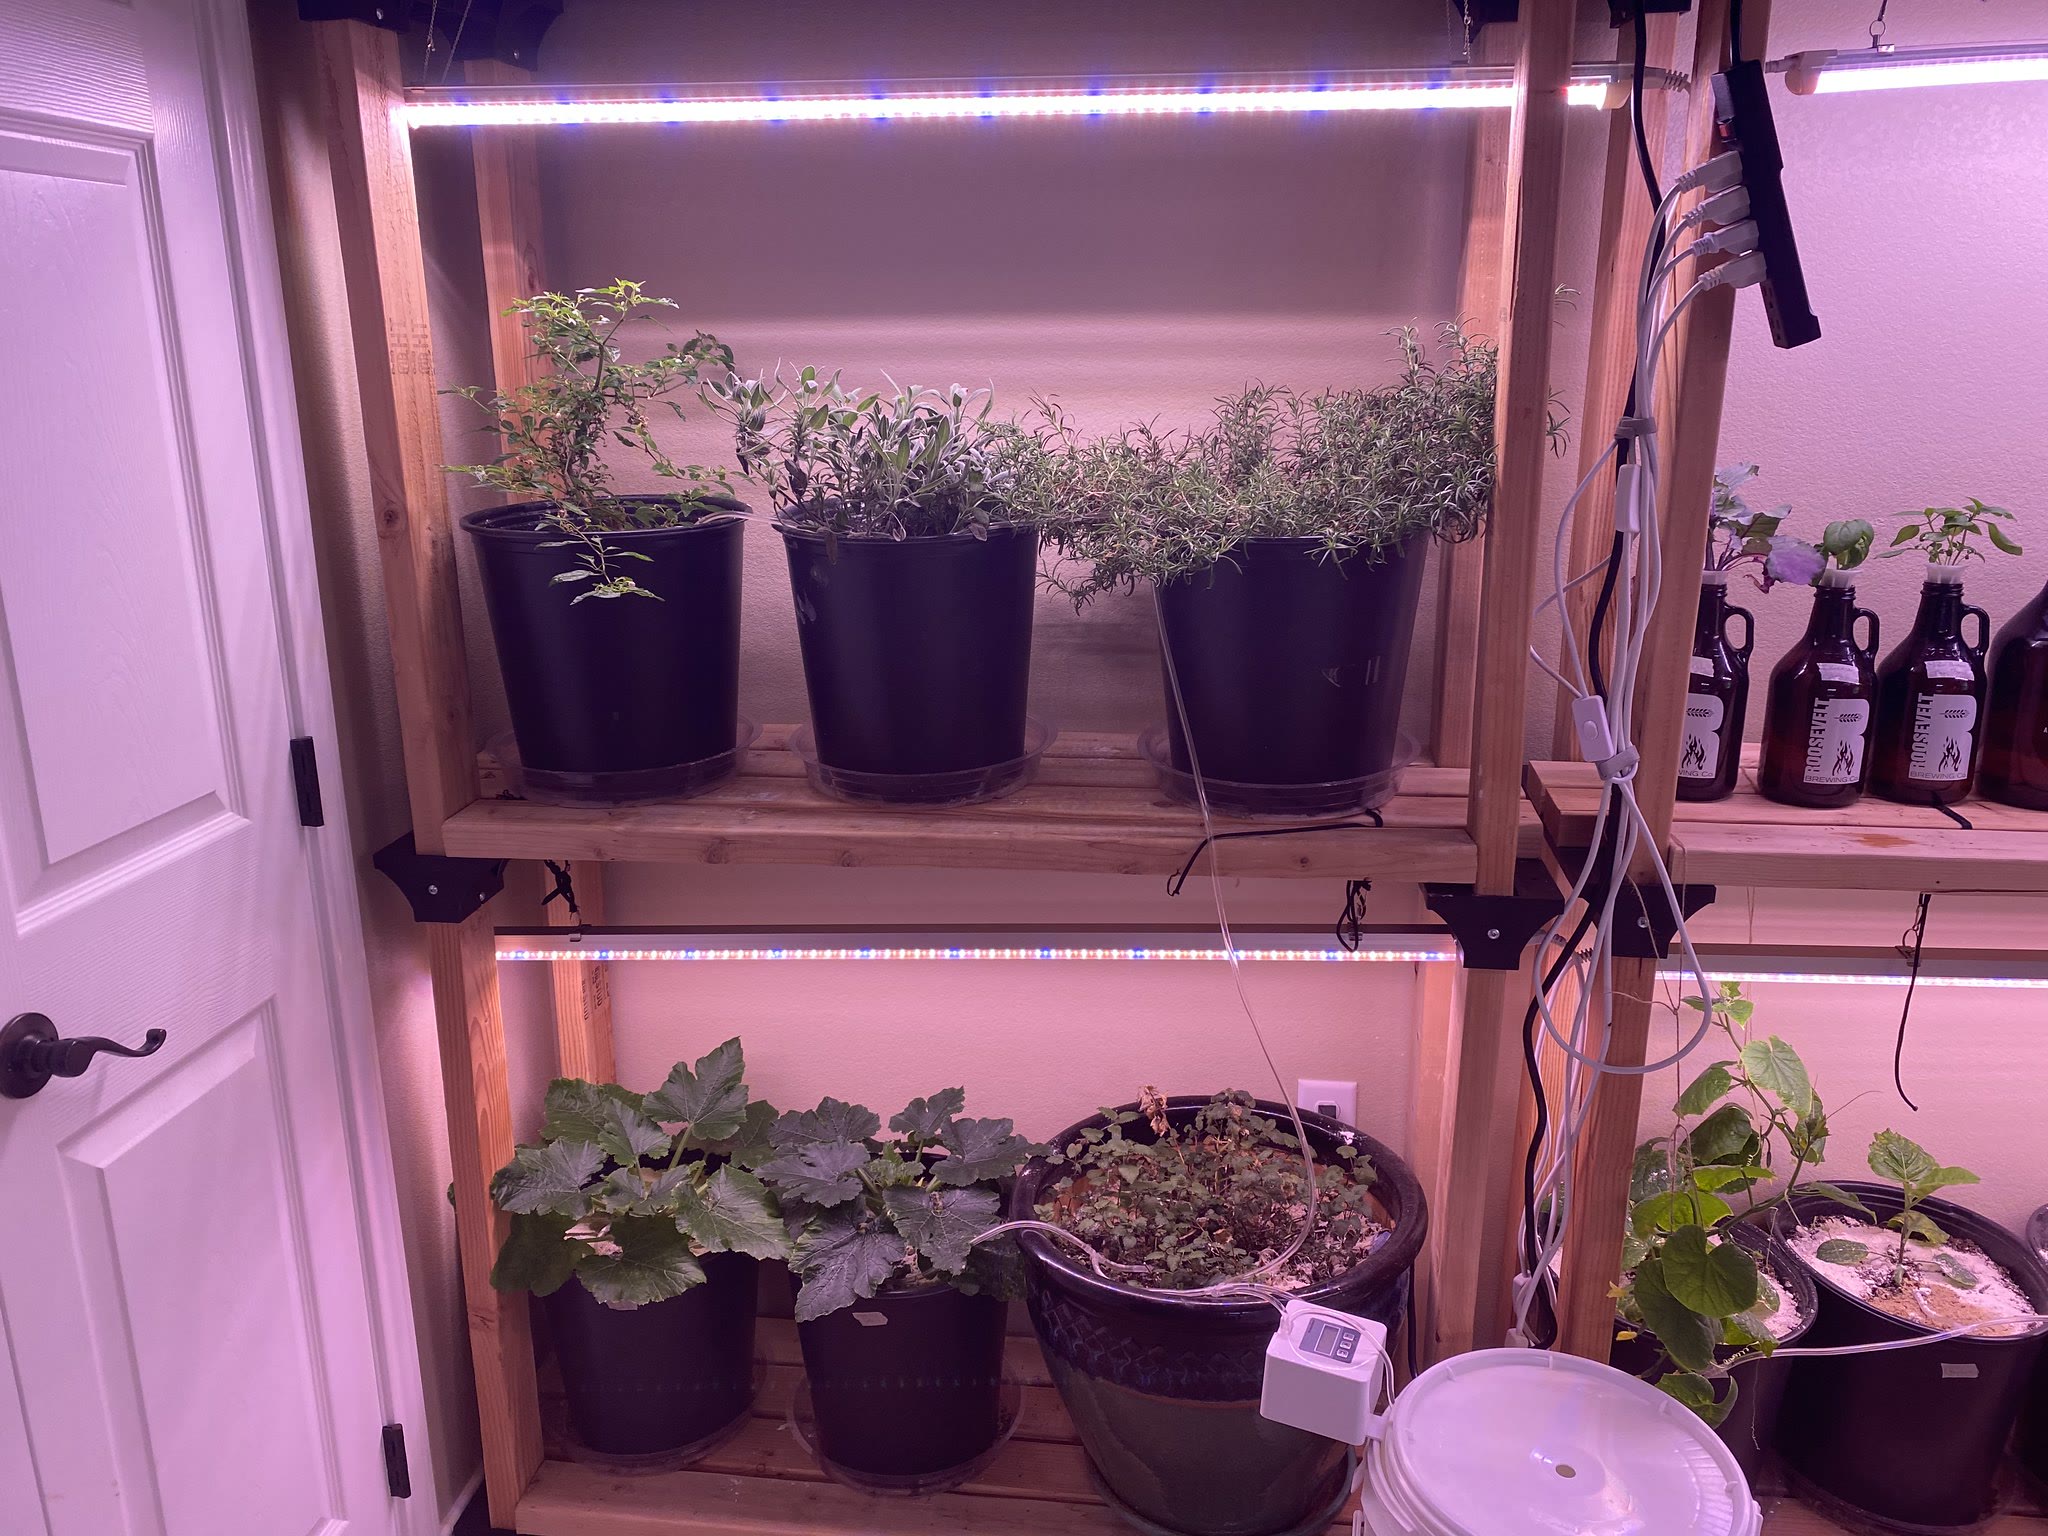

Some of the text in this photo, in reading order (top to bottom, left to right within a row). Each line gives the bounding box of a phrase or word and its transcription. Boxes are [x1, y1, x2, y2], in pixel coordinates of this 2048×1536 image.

[1804, 697, 1831, 774] ROOSEVELT
[1908, 692, 1935, 769] ROOSEVELT
[1804, 775, 1848, 783] BREWING
[1910, 770, 1955, 779] BREWING
